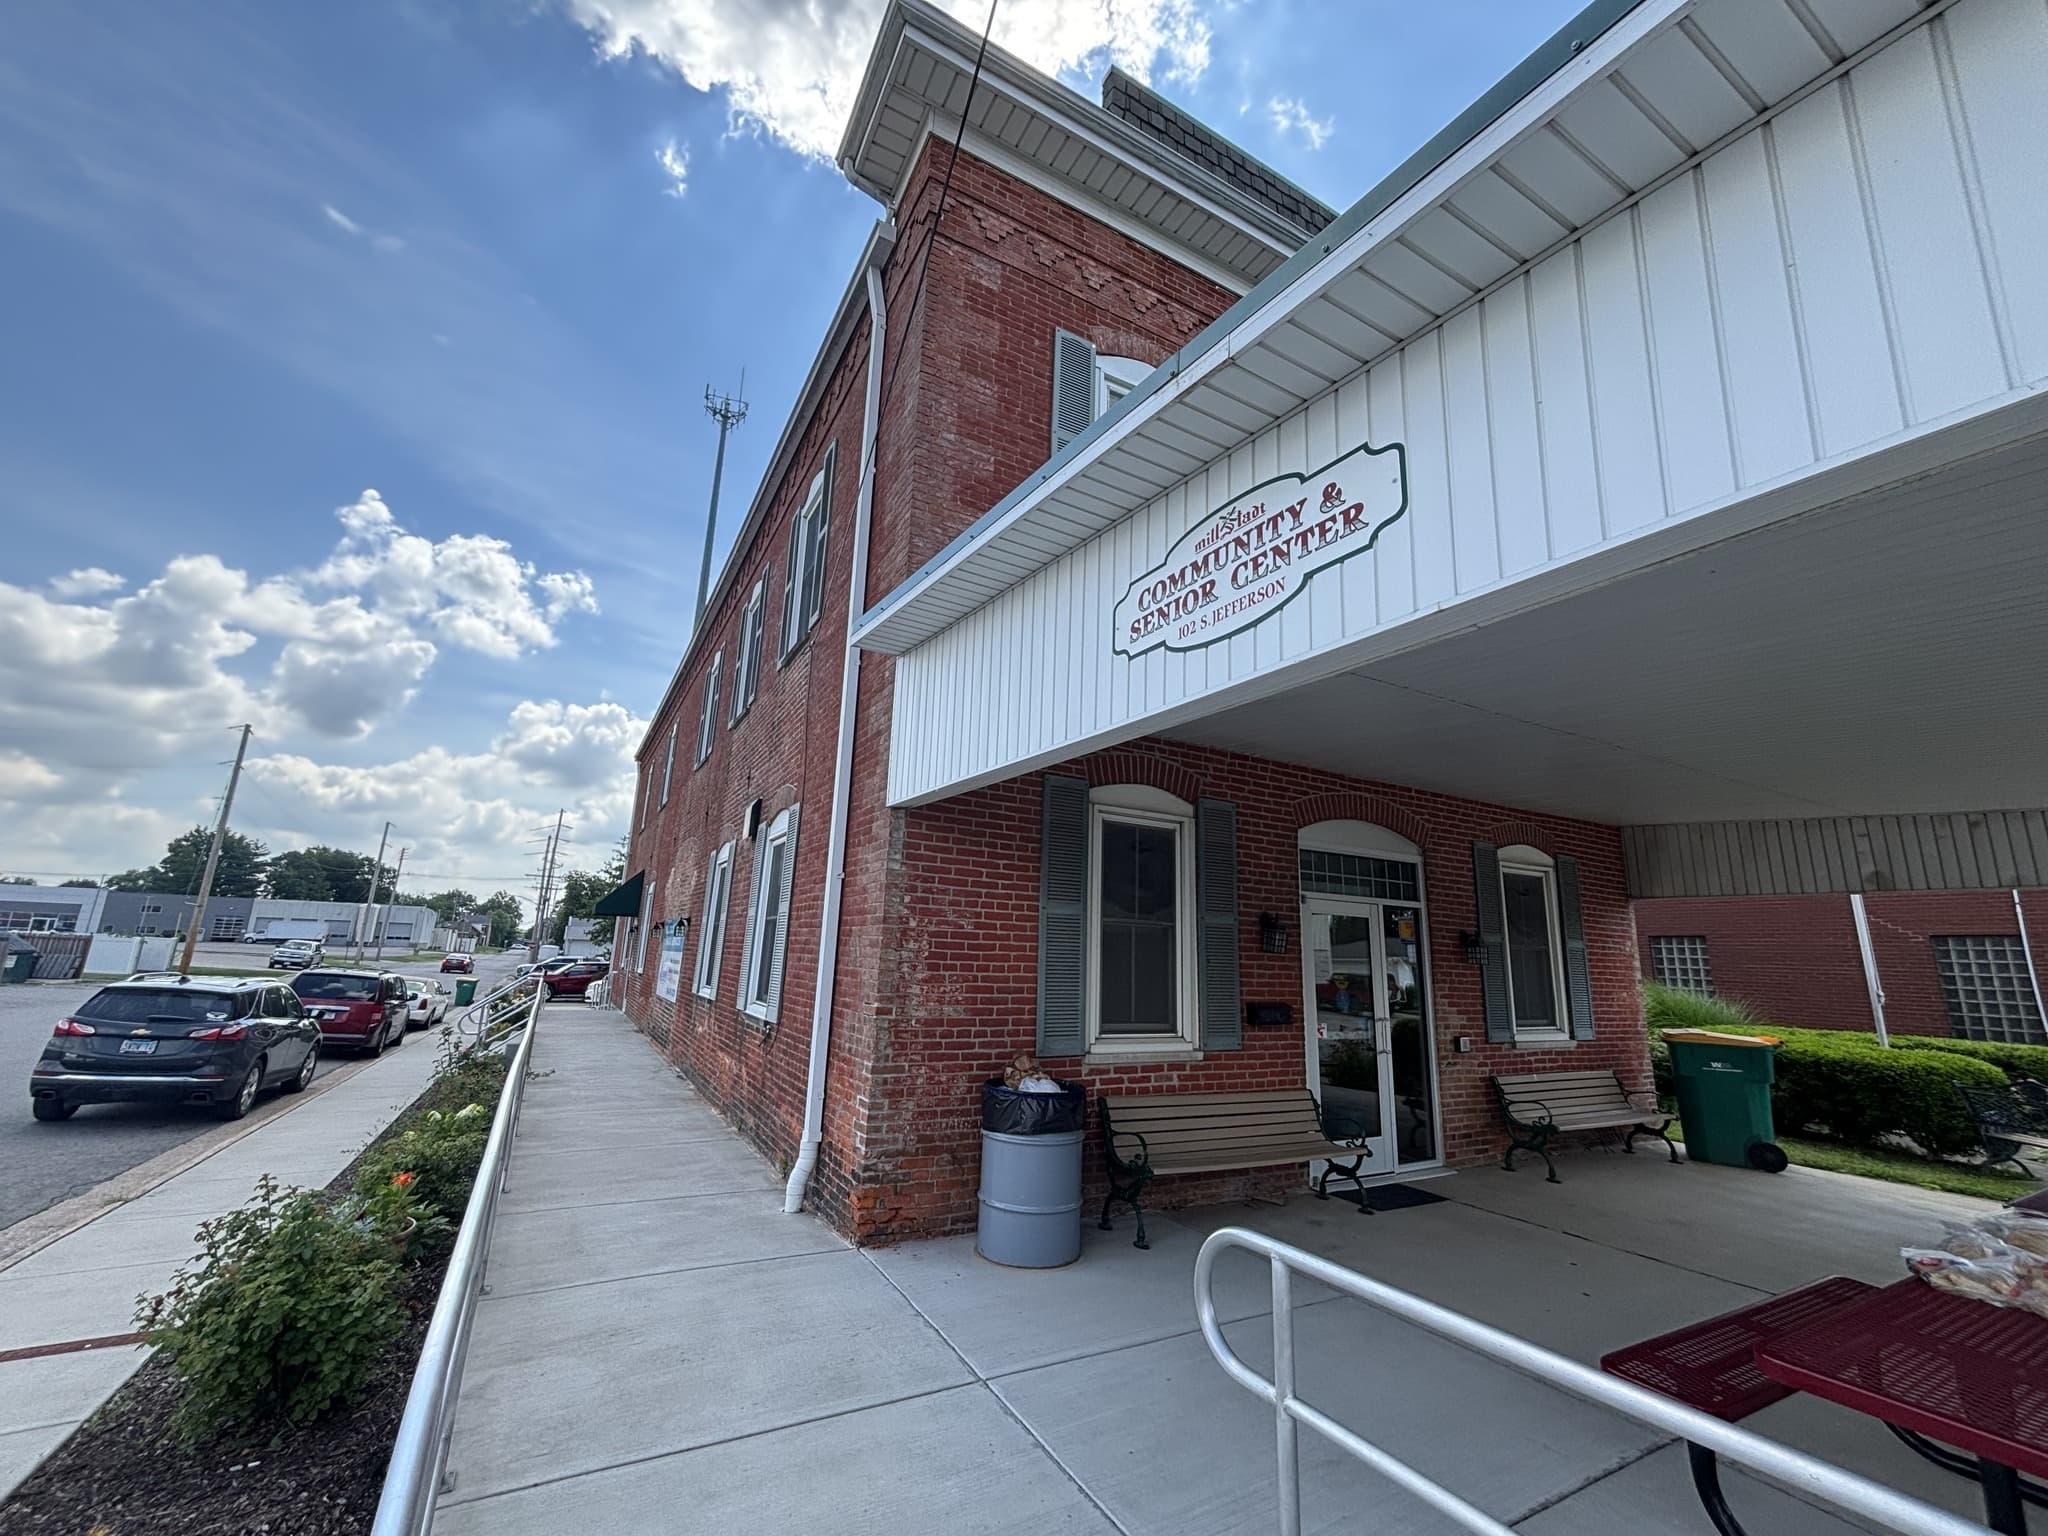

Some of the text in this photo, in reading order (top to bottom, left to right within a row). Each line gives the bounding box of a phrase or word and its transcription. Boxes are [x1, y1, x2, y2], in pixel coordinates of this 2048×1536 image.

[1130, 502, 1369, 644] SENIOR CENTER
[1137, 482, 1346, 612] COMMUNITY &
[1178, 620, 1197, 641] 102
